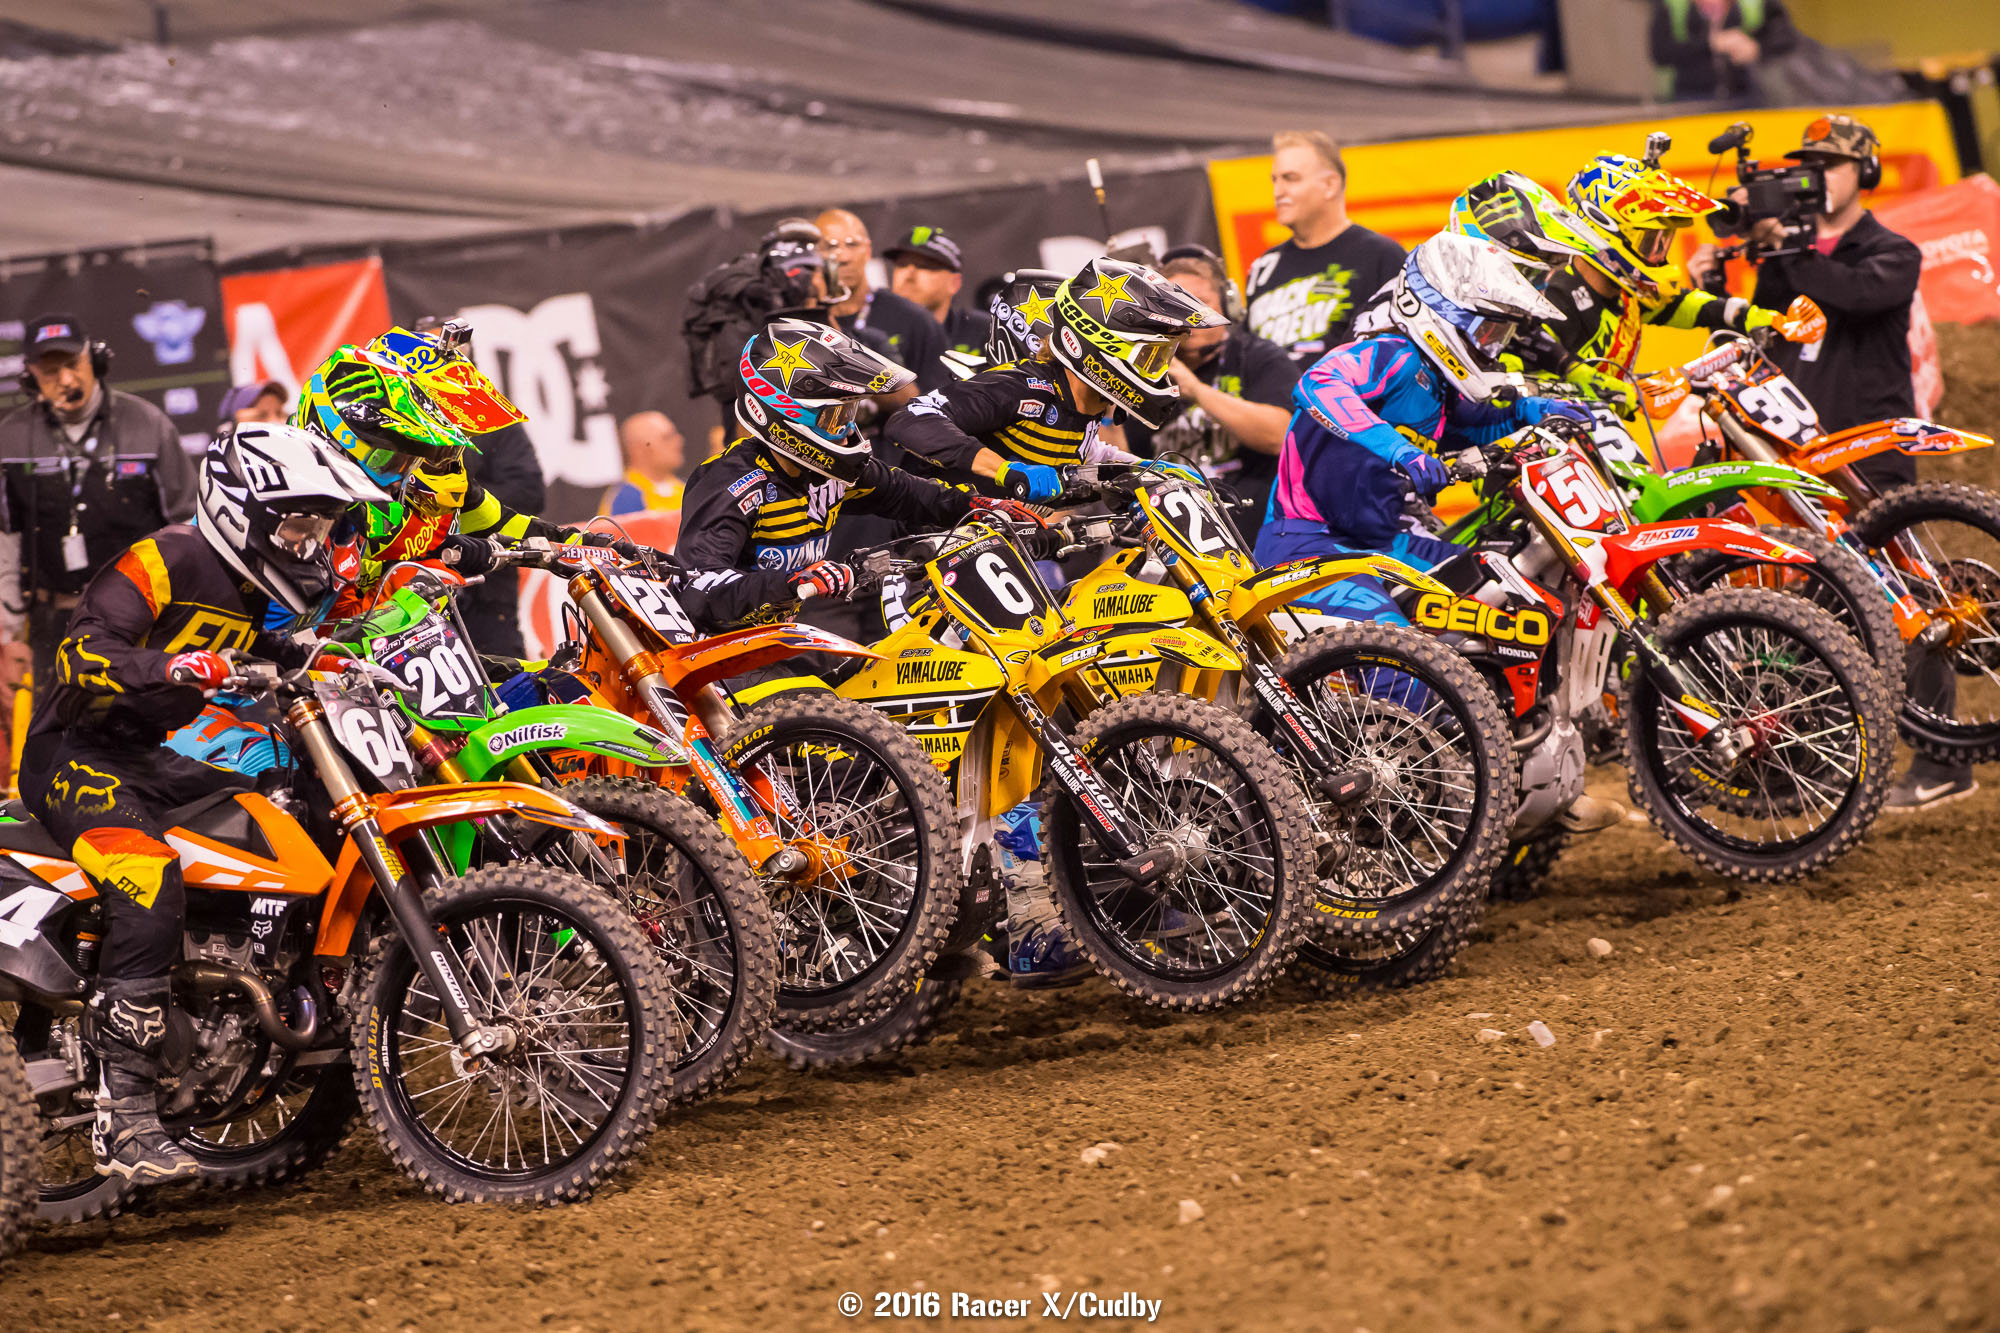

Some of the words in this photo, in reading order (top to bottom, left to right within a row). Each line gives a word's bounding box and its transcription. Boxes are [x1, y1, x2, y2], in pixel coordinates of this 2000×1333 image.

[1063, 331, 1079, 355] BELL
[1425, 332, 1467, 380] GEICO
[1083, 365, 1112, 394] ENERGY
[1111, 389, 1138, 409] DRINK
[746, 398, 764, 422] BELL
[1307, 406, 1350, 440] AMSOIL
[1738, 375, 1818, 440] 30
[769, 434, 800, 457] ENERGY
[729, 469, 766, 494] PARTS
[1668, 471, 1695, 488] PRO
[1698, 465, 1752, 481] CIRCUIT
[1546, 461, 1616, 528] 50
[1638, 527, 1699, 545] AMSOIL
[561, 546, 617, 562] RENTHAL
[975, 551, 1035, 615] 6
[609, 573, 697, 635] 128
[1093, 593, 1158, 620] YAMALUBE
[1416, 593, 1549, 647] GEICO
[674, 632, 693, 644] KTM
[1498, 645, 1539, 660] HONDA
[404, 637, 484, 717] 201
[896, 661, 967, 685] YAMALUBE
[1254, 677, 1288, 716] YAMALUBE
[1255, 663, 1328, 744] DUNLOP
[341, 708, 414, 777] 64
[504, 724, 566, 746] Nilfisk
[724, 724, 774, 761] UNLOP
[1283, 713, 1318, 752] BRAKING
[552, 757, 586, 775] KTM
[1050, 755, 1084, 796] YAMALUBE
[1051, 740, 1126, 823] DUNLOP
[712, 767, 738, 801] MOTOREX
[729, 803, 748, 833] TORK
[1080, 793, 1115, 833] BRAKING
[115, 875, 147, 901] FOX
[250, 897, 288, 917] MTF
[435, 953, 468, 1008] DUNLOP
[364, 1005, 385, 1090] DUNLOP
